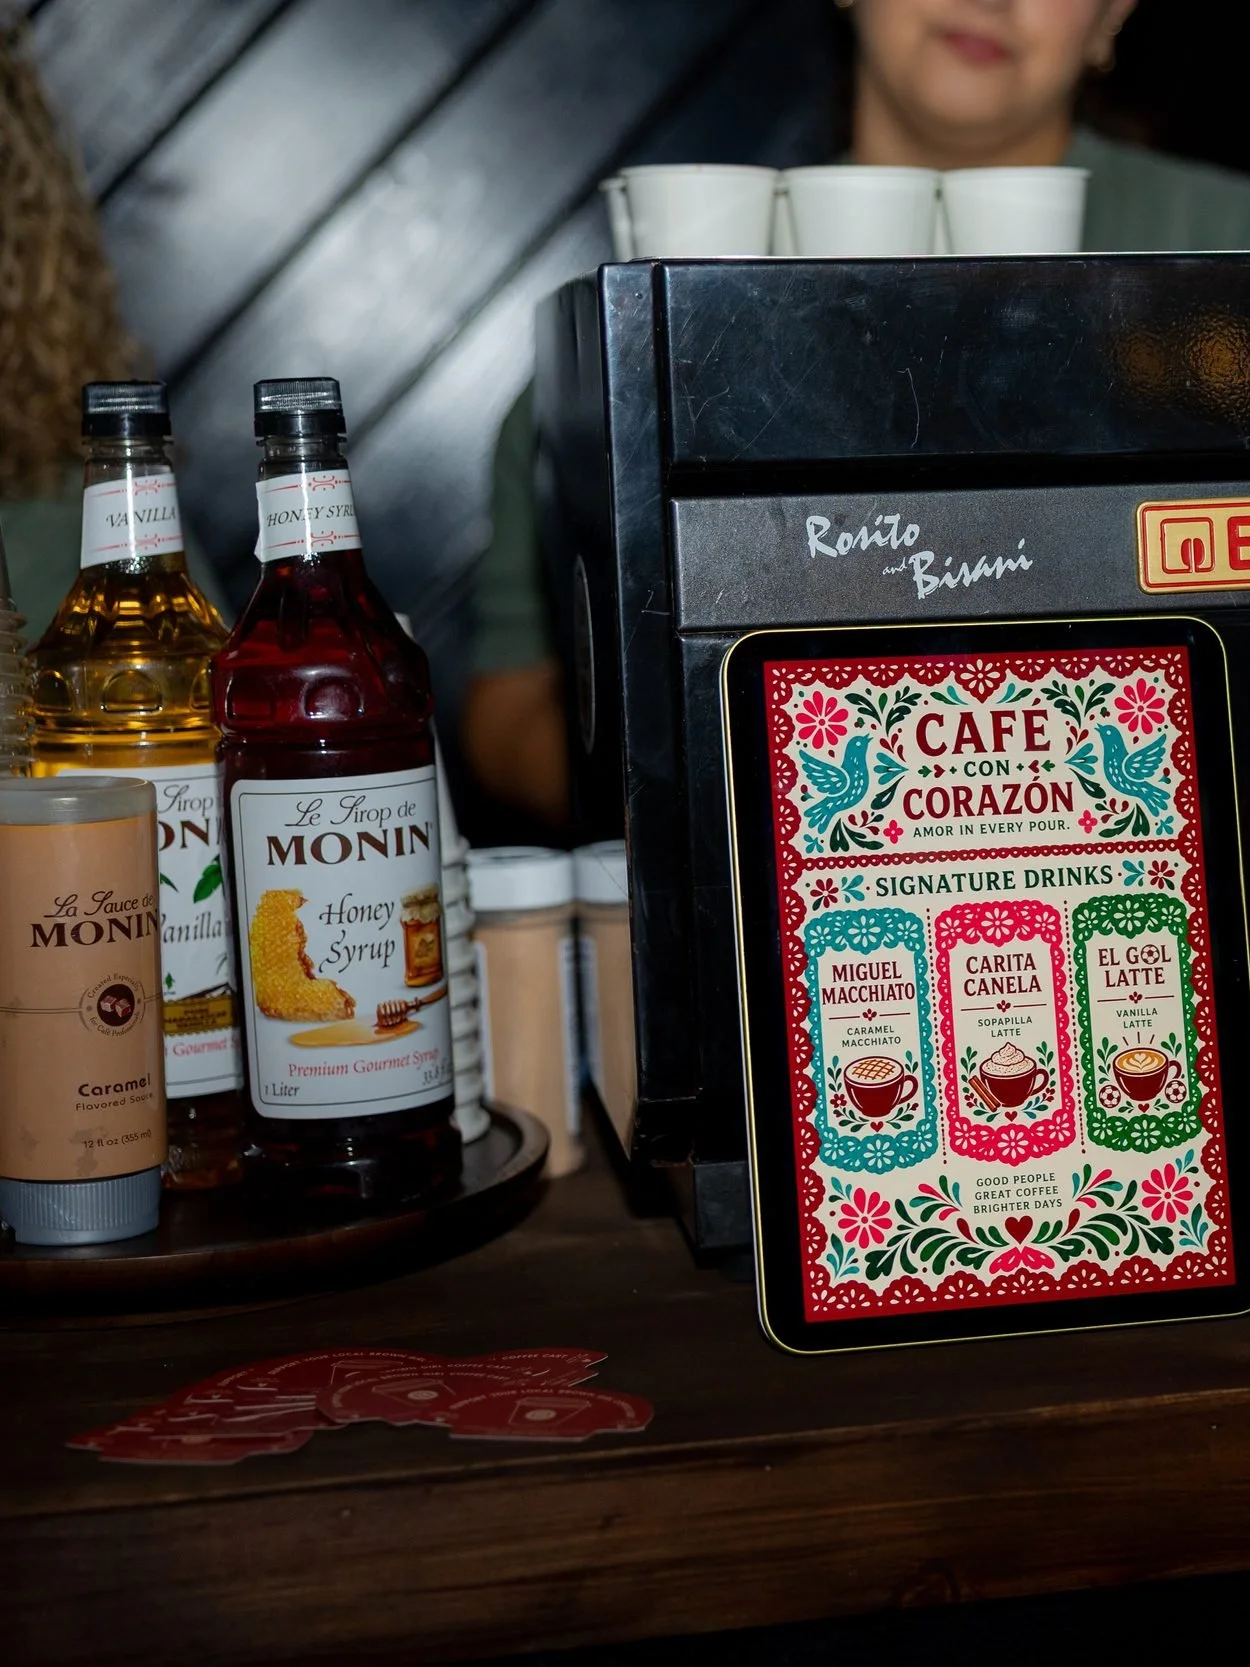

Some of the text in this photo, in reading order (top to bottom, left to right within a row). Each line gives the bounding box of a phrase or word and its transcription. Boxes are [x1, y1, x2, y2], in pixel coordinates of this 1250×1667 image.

[105, 506, 176, 528] VANILLA
[266, 506, 324, 527] HONEY
[805, 514, 920, 559] Rosito
[882, 538, 1033, 600] and Bisani
[915, 697, 1051, 757] CAFÉ
[963, 759, 1010, 778] CON
[157, 784, 214, 818] Sirop
[902, 775, 1074, 821] CORAZÓN
[284, 795, 416, 828] Le Sirop de
[913, 819, 1071, 838] AMOR IN EVERY POUR.
[266, 821, 430, 867] MONIN
[875, 865, 1114, 898] SIGNATURE DRINKS
[44, 890, 154, 918] La Sauce de
[318, 893, 395, 930] Honey
[30, 908, 158, 948] MONIN
[159, 911, 222, 943] anilla
[318, 929, 396, 974] Syrup
[1098, 947, 1121, 967] EL
[832, 961, 902, 983] MIGUEL
[966, 952, 1037, 975] CARITA
[963, 974, 1042, 997] CANELA
[1104, 966, 1166, 988] LATTE
[821, 982, 916, 1006] MACCHIATO
[977, 1015, 1033, 1027] SOPAPILLA
[1116, 1007, 1158, 1018] VANILLA
[846, 1025, 895, 1036] CARAMEL
[991, 1028, 1021, 1038] LATTE
[1123, 1019, 1153, 1029] LATTE
[841, 1036, 902, 1048] MACCHIATO
[288, 1062, 349, 1078] Premium
[353, 1056, 410, 1074] Gourmet
[78, 1072, 151, 1097] Caramel
[272, 1082, 300, 1098] Liter
[75, 1097, 126, 1111] Flavored
[84, 1140, 94, 1149] 12
[106, 1138, 119, 1146] oz
[976, 1172, 1056, 1187] GOOD PEOPLE
[974, 1185, 1059, 1201] GREAT COFFEE
[973, 1198, 1063, 1214] BRIGHTER DAYS
